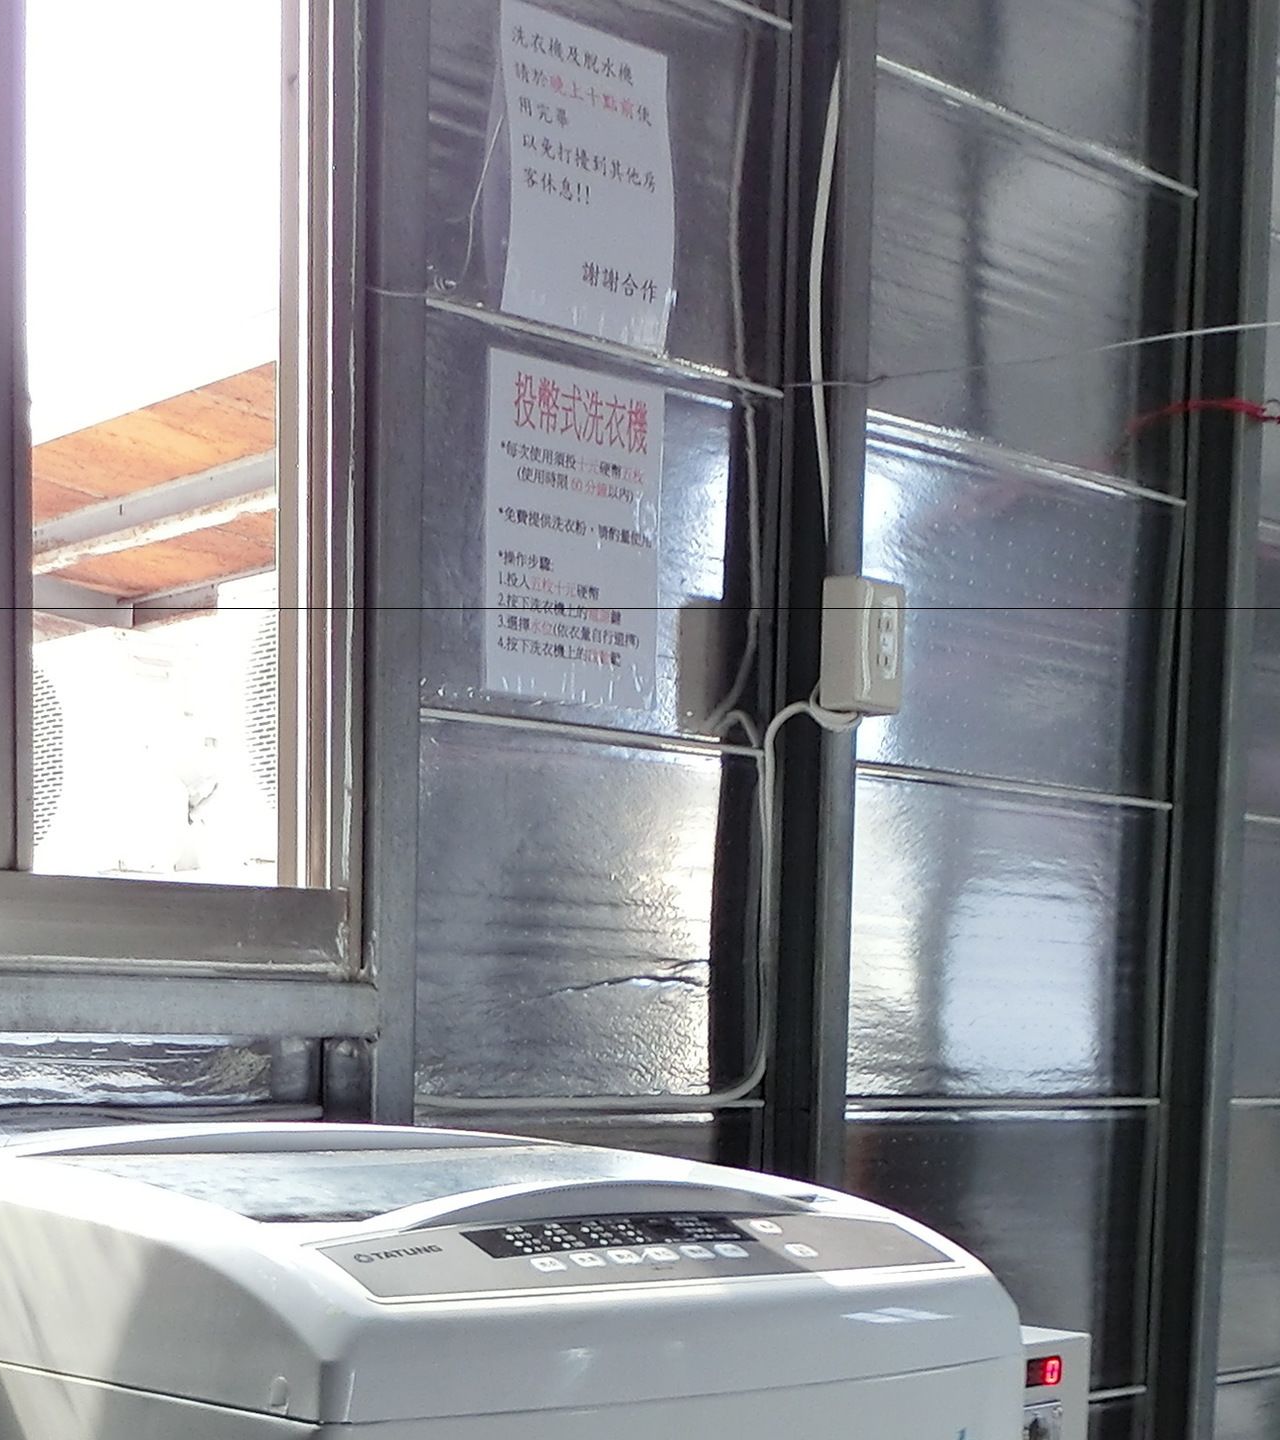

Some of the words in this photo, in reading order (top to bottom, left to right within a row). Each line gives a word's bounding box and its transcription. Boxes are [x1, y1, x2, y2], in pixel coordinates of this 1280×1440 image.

[512, 25, 633, 86] 洗衣機及脫水機
[515, 62, 652, 127] 請於晚上十點前使
[519, 96, 568, 128] 用完畢
[582, 261, 657, 304] 謝謝合作
[514, 371, 648, 455] 投幣式洗衣機
[371, 1244, 443, 1260] TATUNG
[1044, 1359, 1059, 1384] 0
